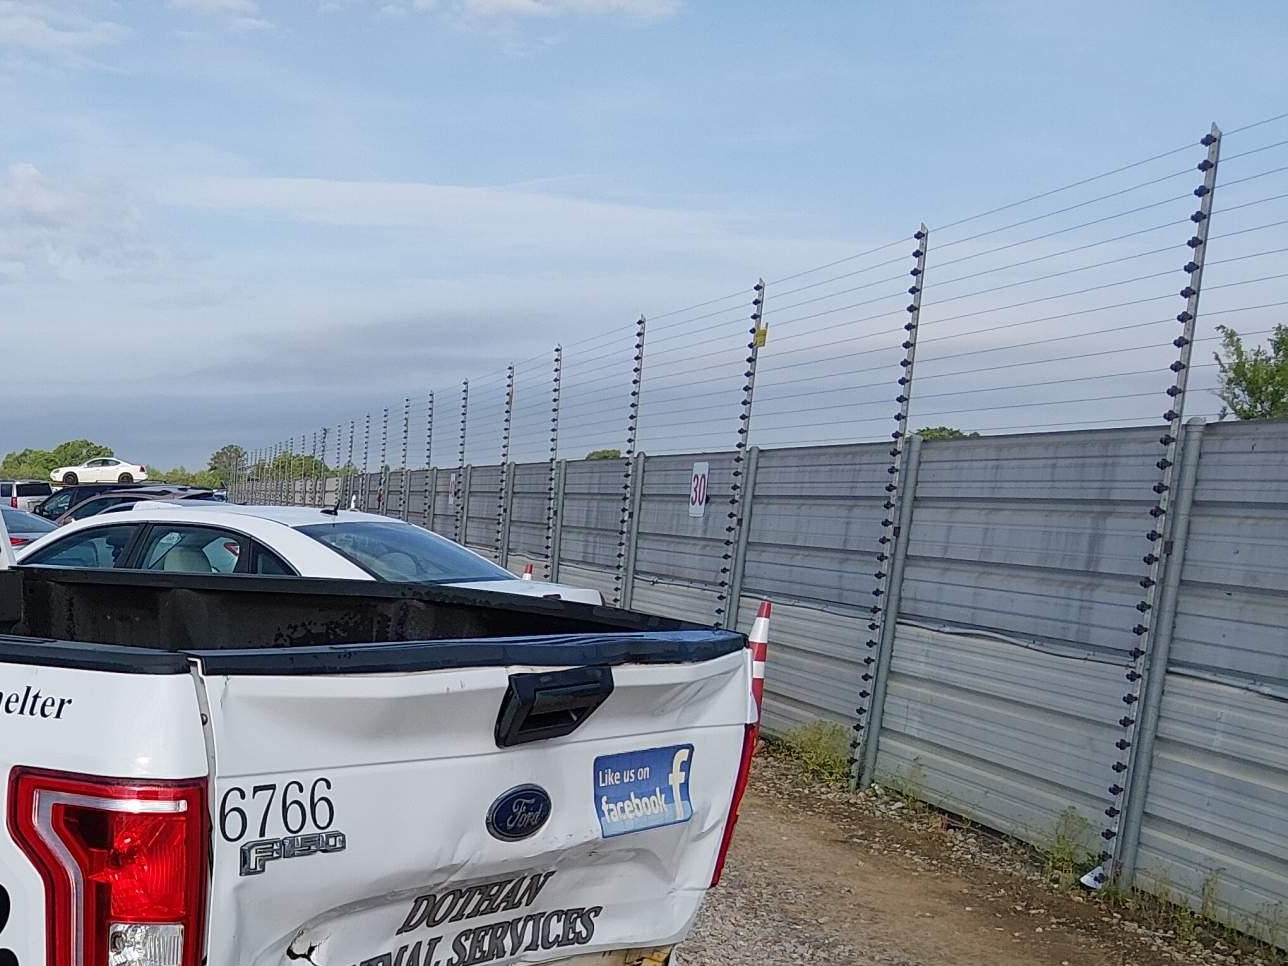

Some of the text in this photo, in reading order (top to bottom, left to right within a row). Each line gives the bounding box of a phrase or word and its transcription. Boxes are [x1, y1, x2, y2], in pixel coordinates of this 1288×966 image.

[691, 473, 706, 506] 30
[599, 766, 650, 787] Like us on
[219, 777, 335, 842] 6766
[506, 798, 544, 830] Ford
[601, 787, 668, 823] facebook
[395, 869, 557, 936] DOTHAN
